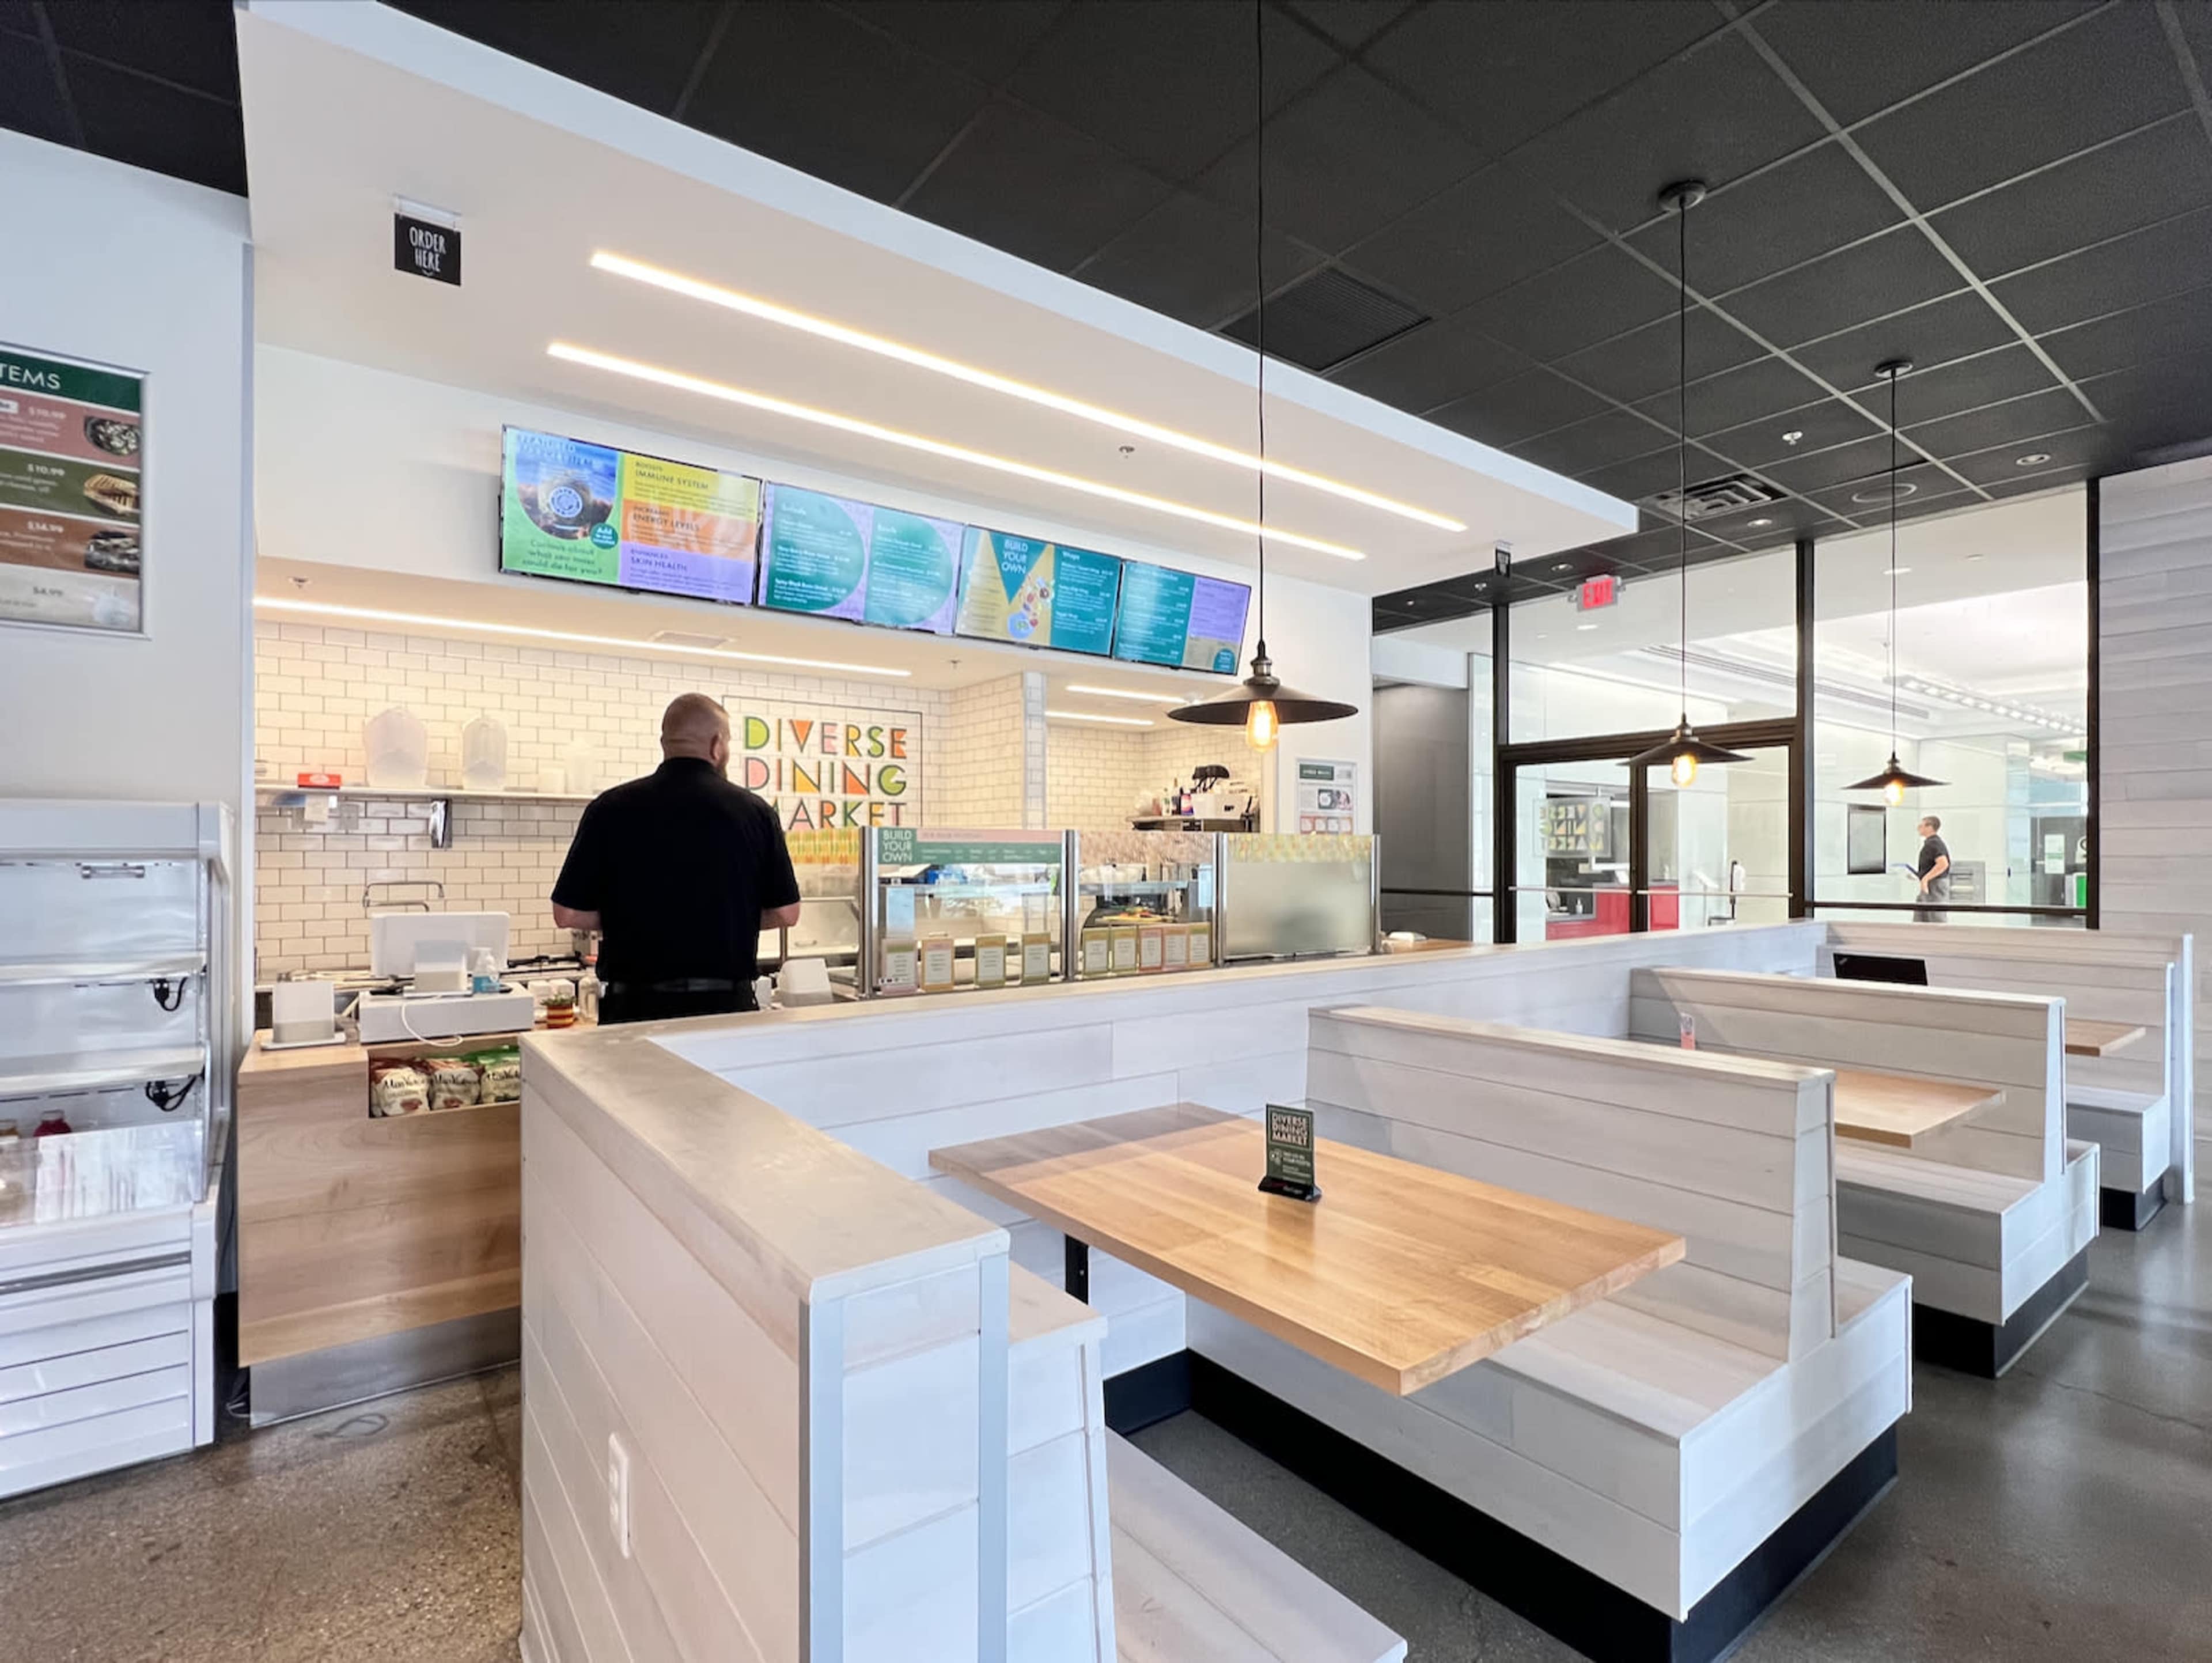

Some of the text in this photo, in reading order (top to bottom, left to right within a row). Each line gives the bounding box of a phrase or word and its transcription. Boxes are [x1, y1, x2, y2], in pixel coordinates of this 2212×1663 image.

[408, 226, 446, 254] ORDER
[414, 248, 441, 272] HERE
[27, 463, 65, 476] $10.99
[635, 469, 709, 490] IMMUNE SYSTEM
[633, 513, 699, 532] ENERGY LEVELS
[1005, 539, 1028, 552] BUILD
[631, 556, 687, 571] SKIN HEALTH
[1003, 551, 1027, 563] YOUR
[1001, 561, 1026, 574] OWN
[1583, 578, 1613, 609] EXIT
[743, 716, 907, 759] DIVERSE
[744, 757, 907, 796] DINING
[773, 796, 907, 830] ARKET
[882, 829, 912, 840] BUILD
[882, 840, 912, 851] YOUR
[882, 851, 912, 862] OWN
[1272, 1112, 1306, 1127] DIVERSE
[1272, 1122, 1307, 1137] DINING
[1272, 1132, 1307, 1146] MARKET
